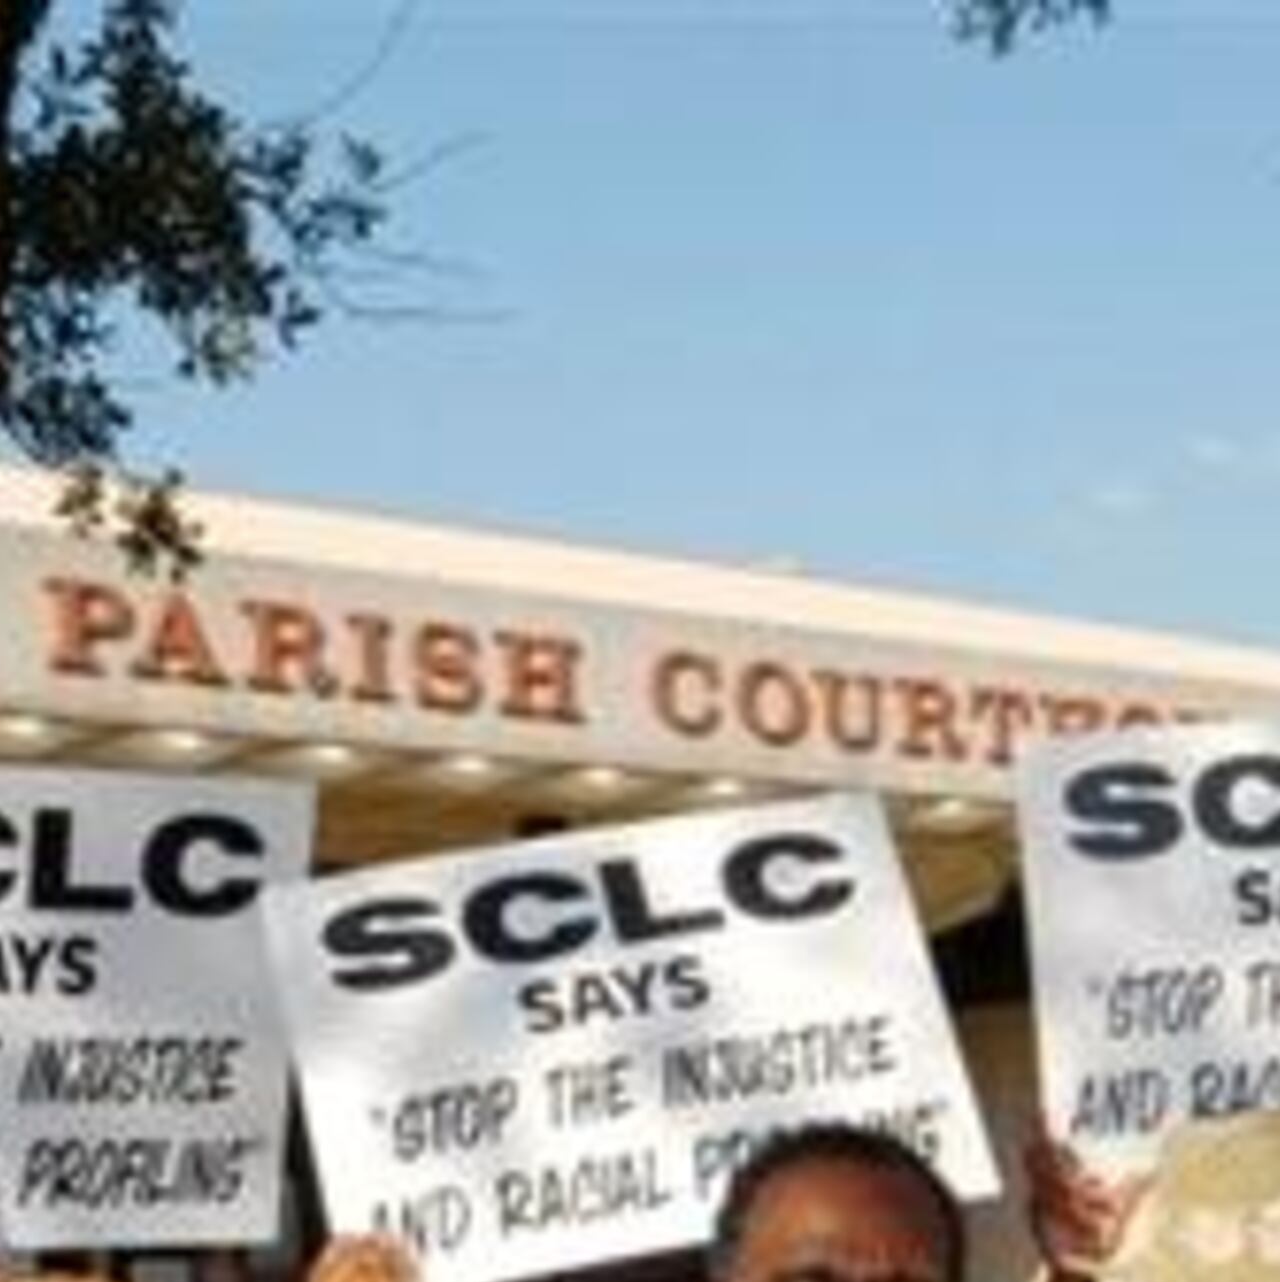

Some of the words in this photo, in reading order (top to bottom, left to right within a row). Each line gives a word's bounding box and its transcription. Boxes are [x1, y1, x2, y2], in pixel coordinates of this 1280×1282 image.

[41, 577, 586, 727] PARISH
[653, 648, 1230, 768] COURT
[320, 831, 857, 993] SCLC
[520, 955, 712, 1033] SAYS
[23, 1037, 245, 1102] INJUSTICE
[548, 1056, 634, 1127] THE
[662, 1015, 899, 1106] INJUSTICE
[1071, 1066, 1172, 1137] AND
[497, 1147, 672, 1235] RACIAL
